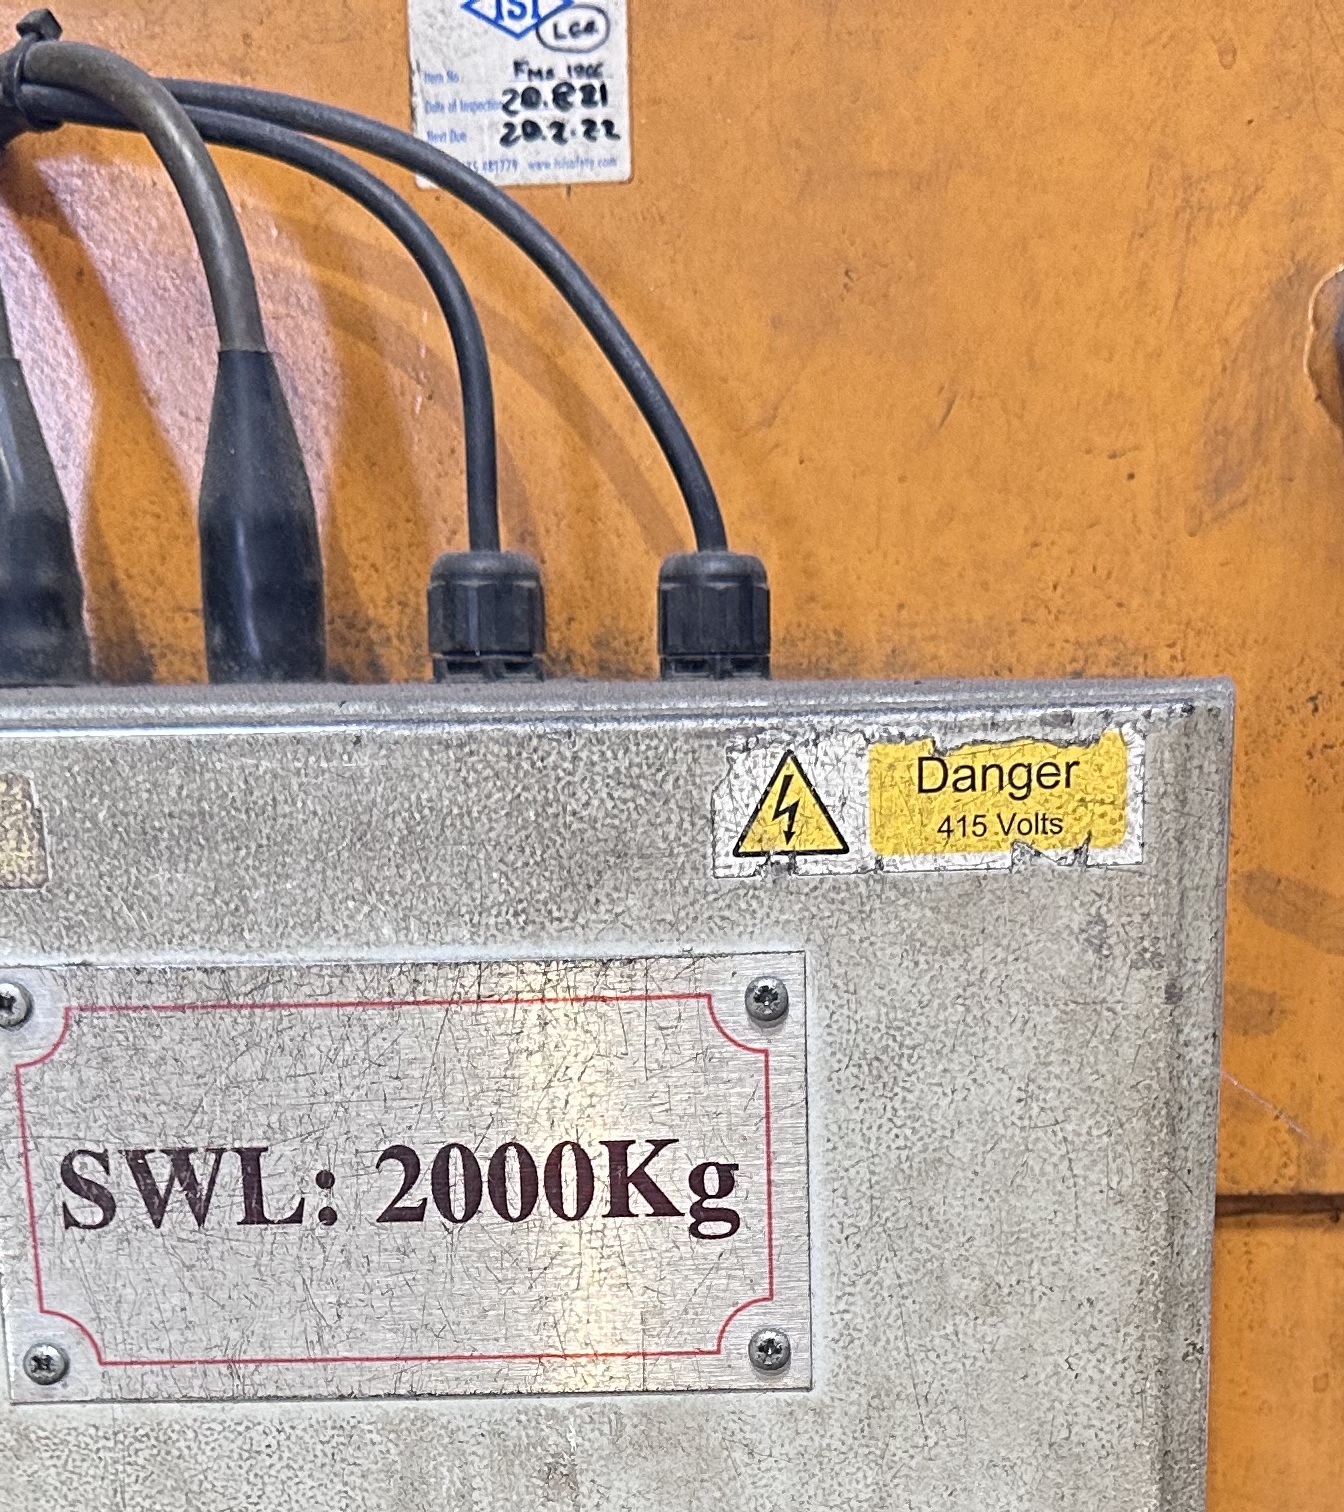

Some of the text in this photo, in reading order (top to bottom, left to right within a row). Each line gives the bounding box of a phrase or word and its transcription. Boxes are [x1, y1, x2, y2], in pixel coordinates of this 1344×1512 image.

[425, 100, 445, 113] Date
[448, 98, 457, 112] of
[427, 129, 468, 142] Next Due
[917, 756, 1080, 800] Danger
[937, 812, 1064, 839] 415 Volts
[60, 1138, 740, 1240] SWL: 2000Kg
